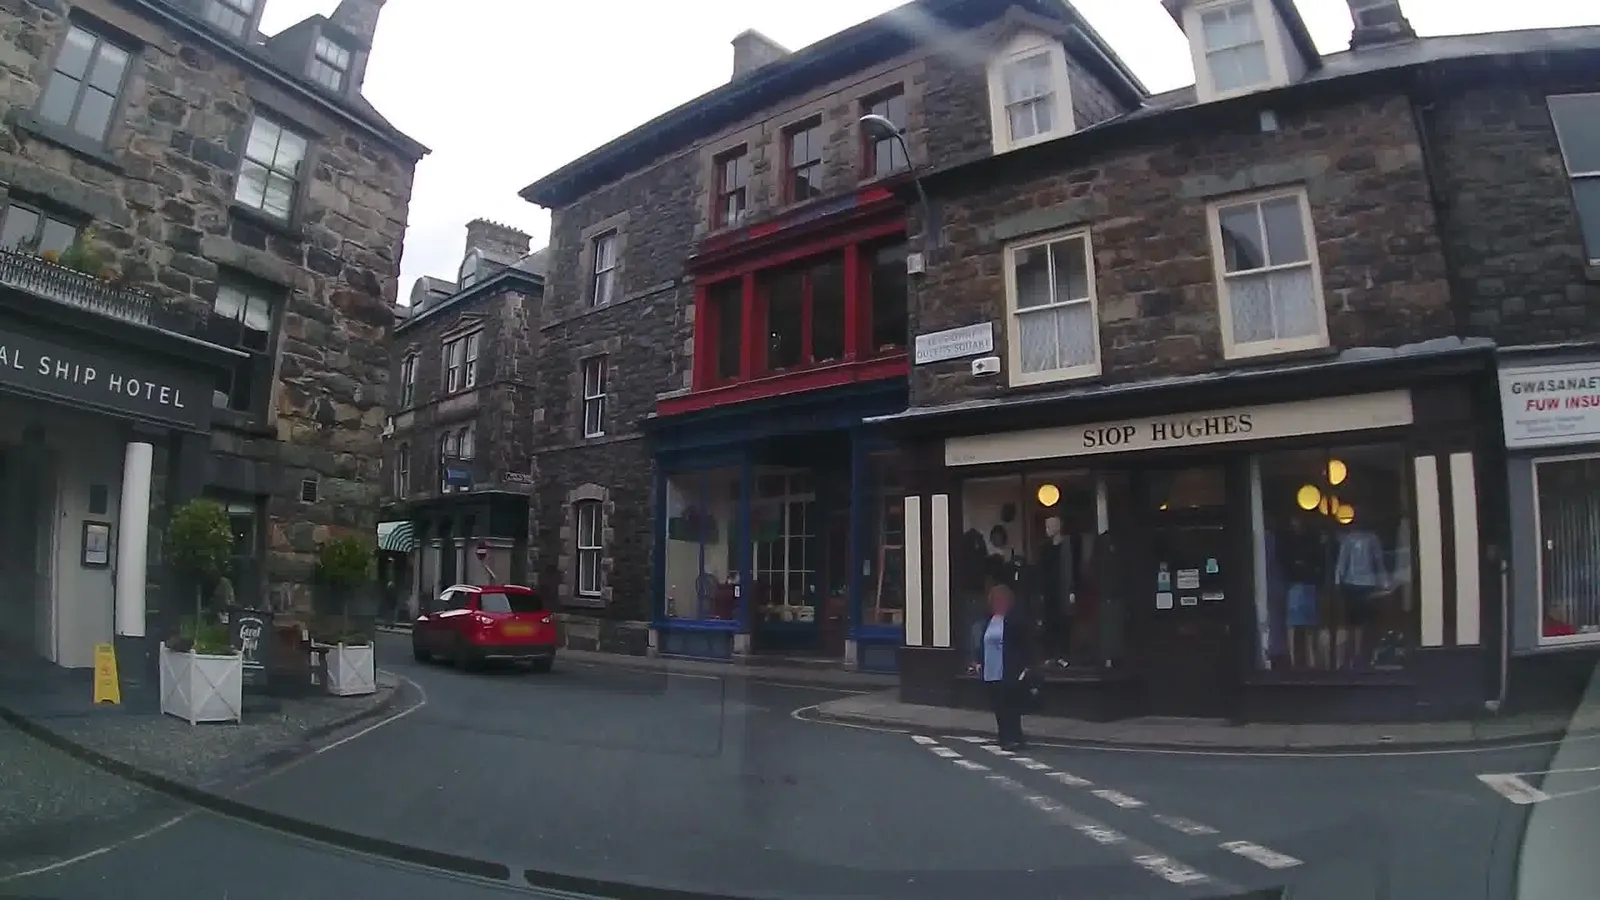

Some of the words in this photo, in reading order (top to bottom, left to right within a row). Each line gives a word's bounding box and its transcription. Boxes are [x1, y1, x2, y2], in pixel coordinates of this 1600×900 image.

[39, 356, 96, 384] SHIP
[109, 374, 184, 408] HOTEL
[1526, 398, 1560, 411] FUW
[1083, 426, 1136, 447] SIOP
[1152, 414, 1253, 441] HUGHES
